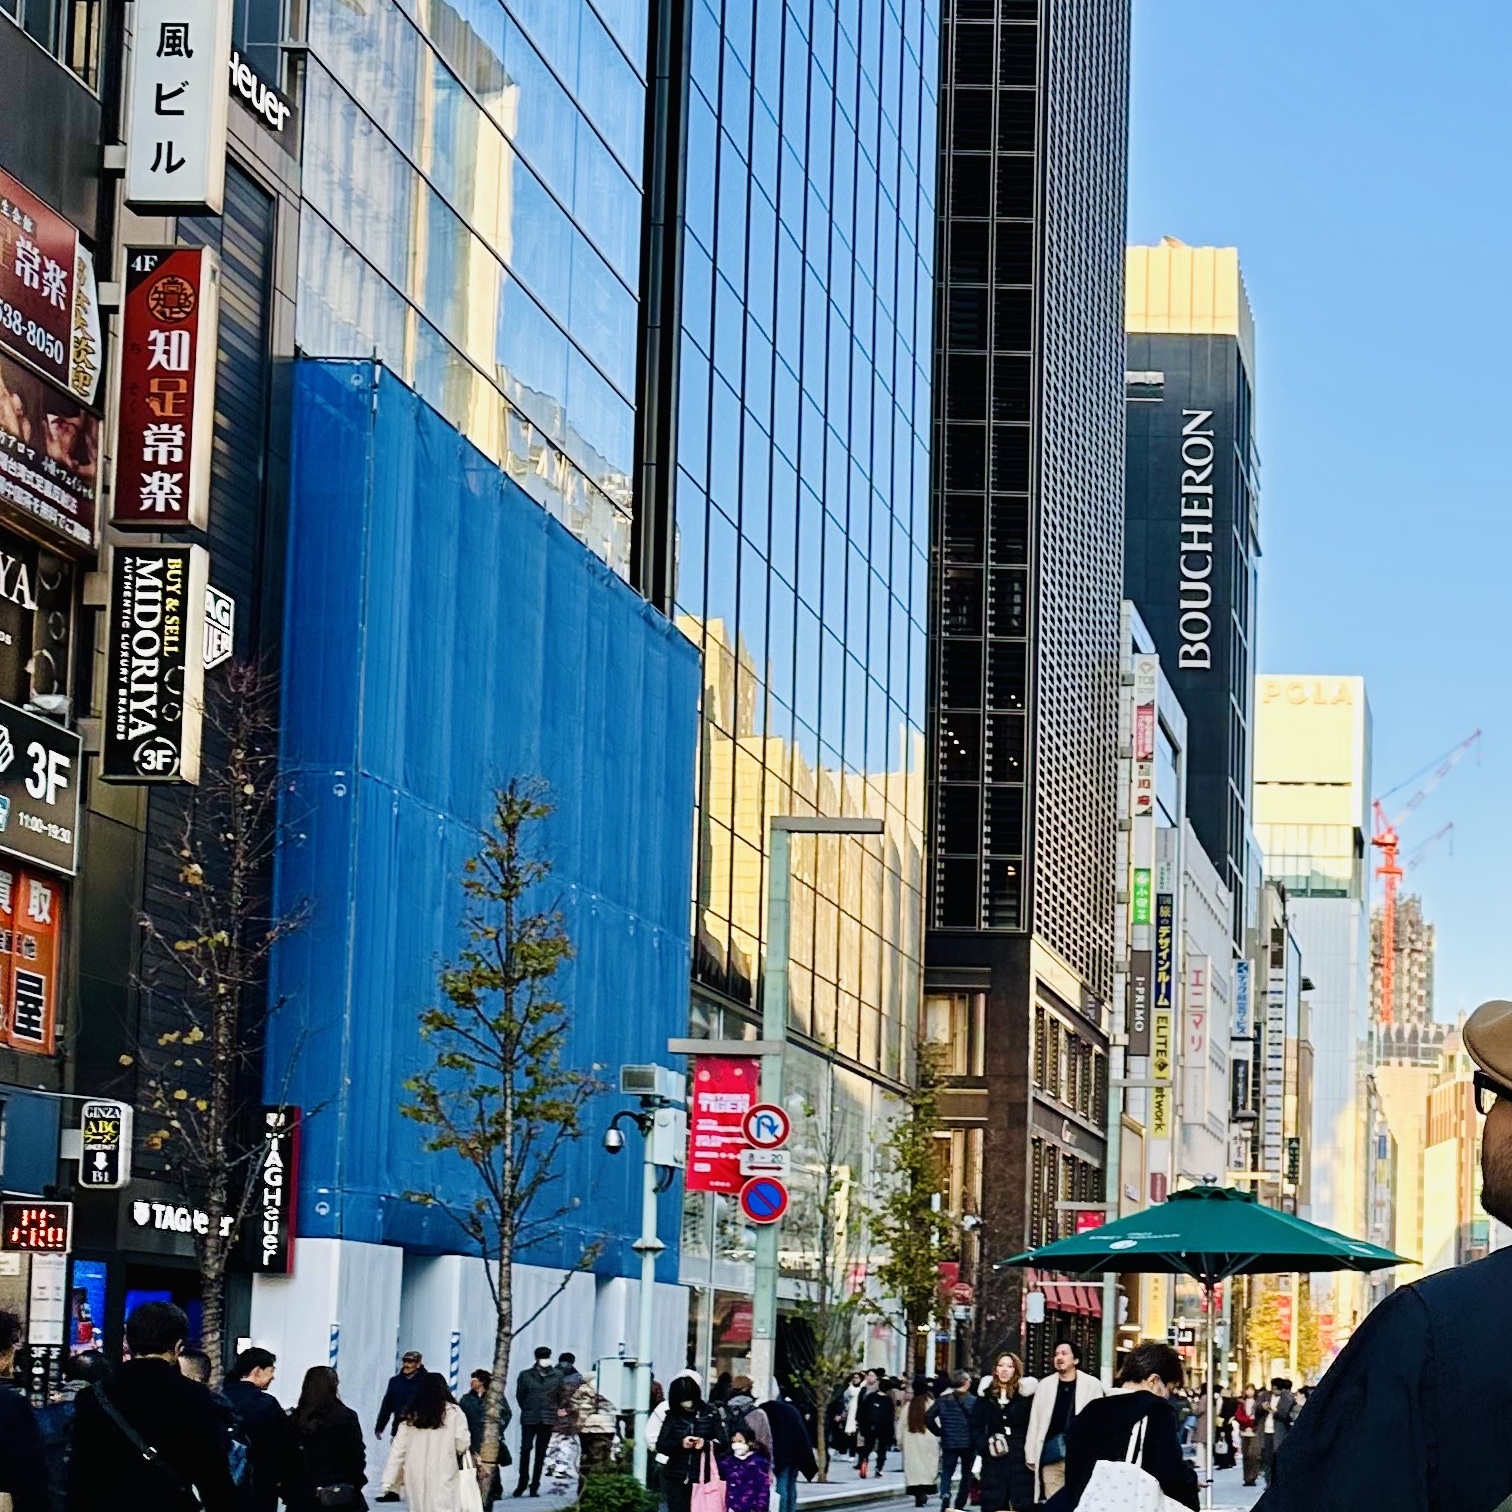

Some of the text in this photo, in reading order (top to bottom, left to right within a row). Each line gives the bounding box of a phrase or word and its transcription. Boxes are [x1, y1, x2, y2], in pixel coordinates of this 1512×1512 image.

[150, 22, 194, 174] 風ビル
[130, 254, 159, 272] 4F
[0, 297, 64, 365] 38-8050
[139, 329, 191, 513] 知足常楽
[1178, 408, 1215, 671] BOUCHERON
[163, 557, 183, 658] BUY & SELL
[115, 556, 134, 741] AUTHENTIC LUXURY BRANDS
[127, 556, 164, 741] MIDORIYA
[1263, 679, 1355, 705] POLA
[25, 741, 71, 805] 3F
[141, 749, 174, 772] 3F
[1157, 905, 1171, 1007] 旅のデザインルーム
[1155, 1015, 1169, 1058] ELITE
[1190, 970, 1203, 1052] エニマリ
[83, 1131, 120, 1144] ラーメン
[84, 1106, 121, 1119] GINZA
[86, 1120, 120, 1134] ABC
[91, 1170, 109, 1182] B1
